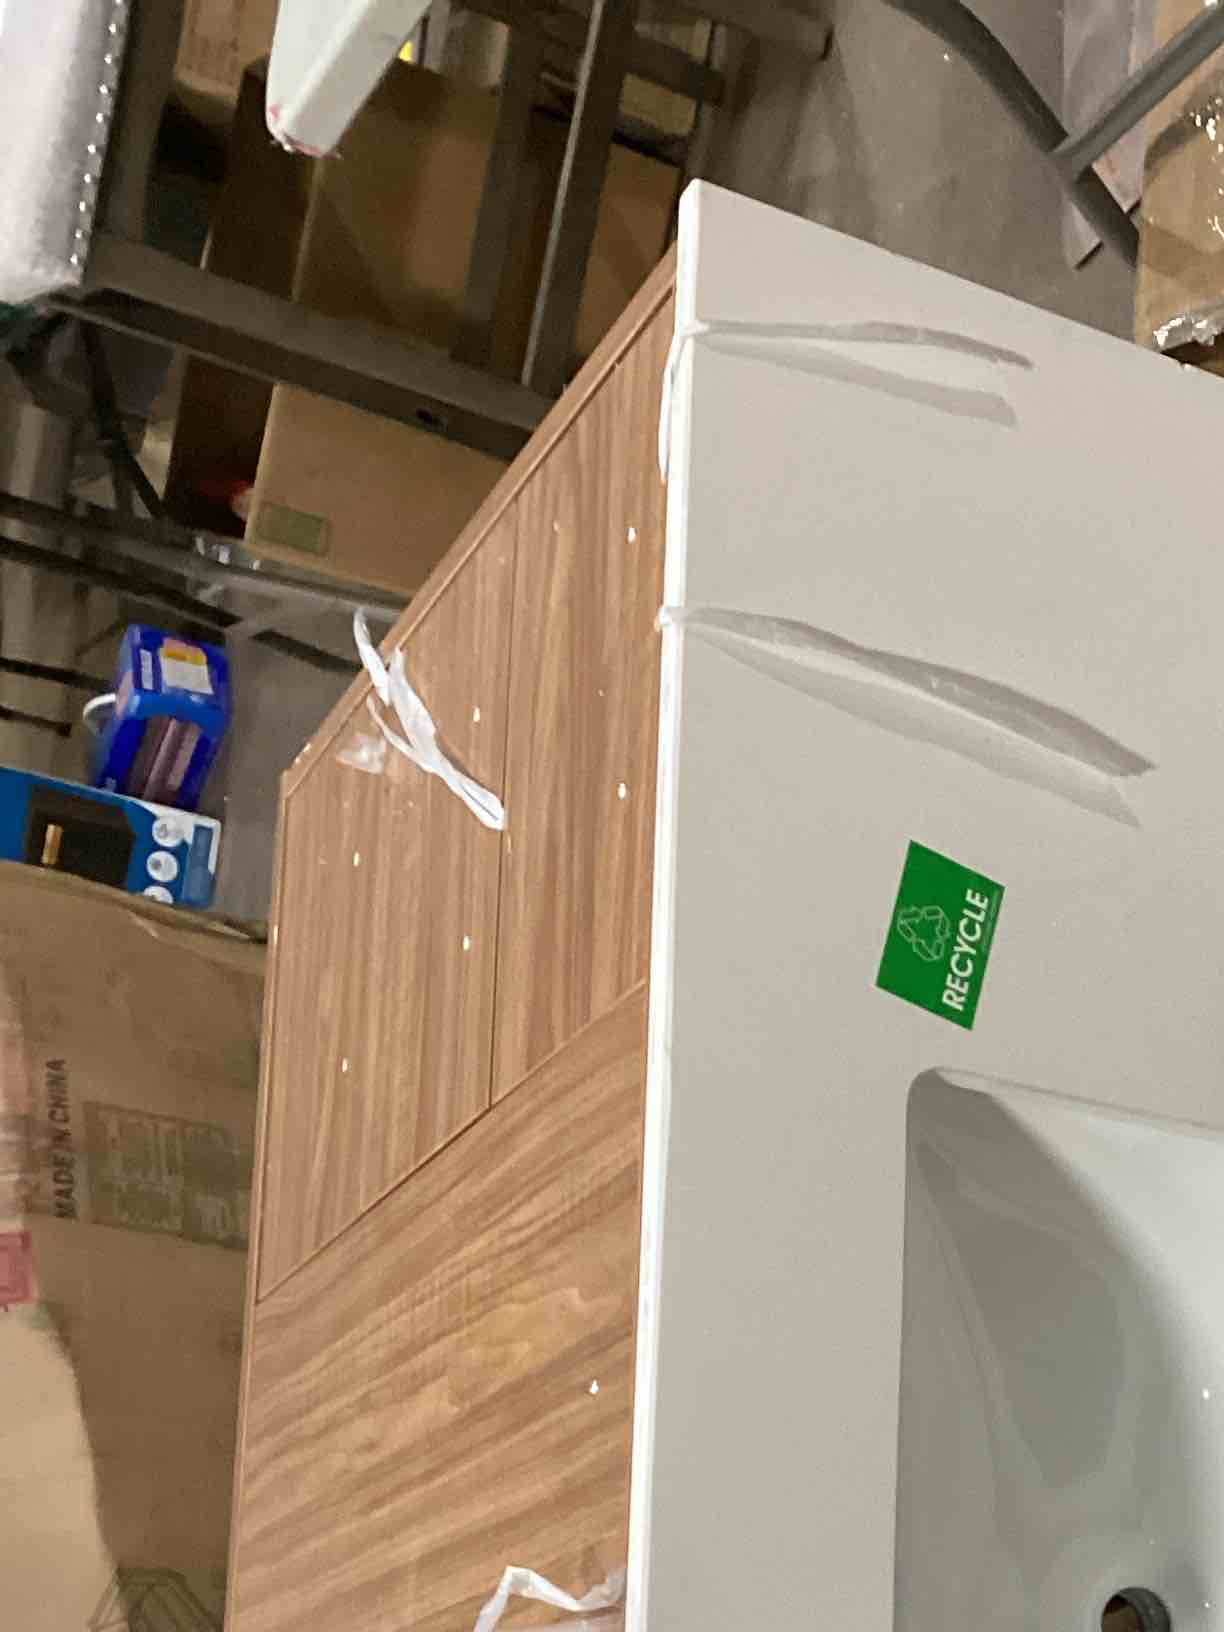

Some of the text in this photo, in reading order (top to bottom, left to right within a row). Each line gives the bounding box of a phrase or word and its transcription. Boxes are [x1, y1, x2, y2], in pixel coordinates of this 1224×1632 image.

[942, 888, 989, 1012] RECYCLE
[45, 1058, 77, 1219] MADE IN CHINA
